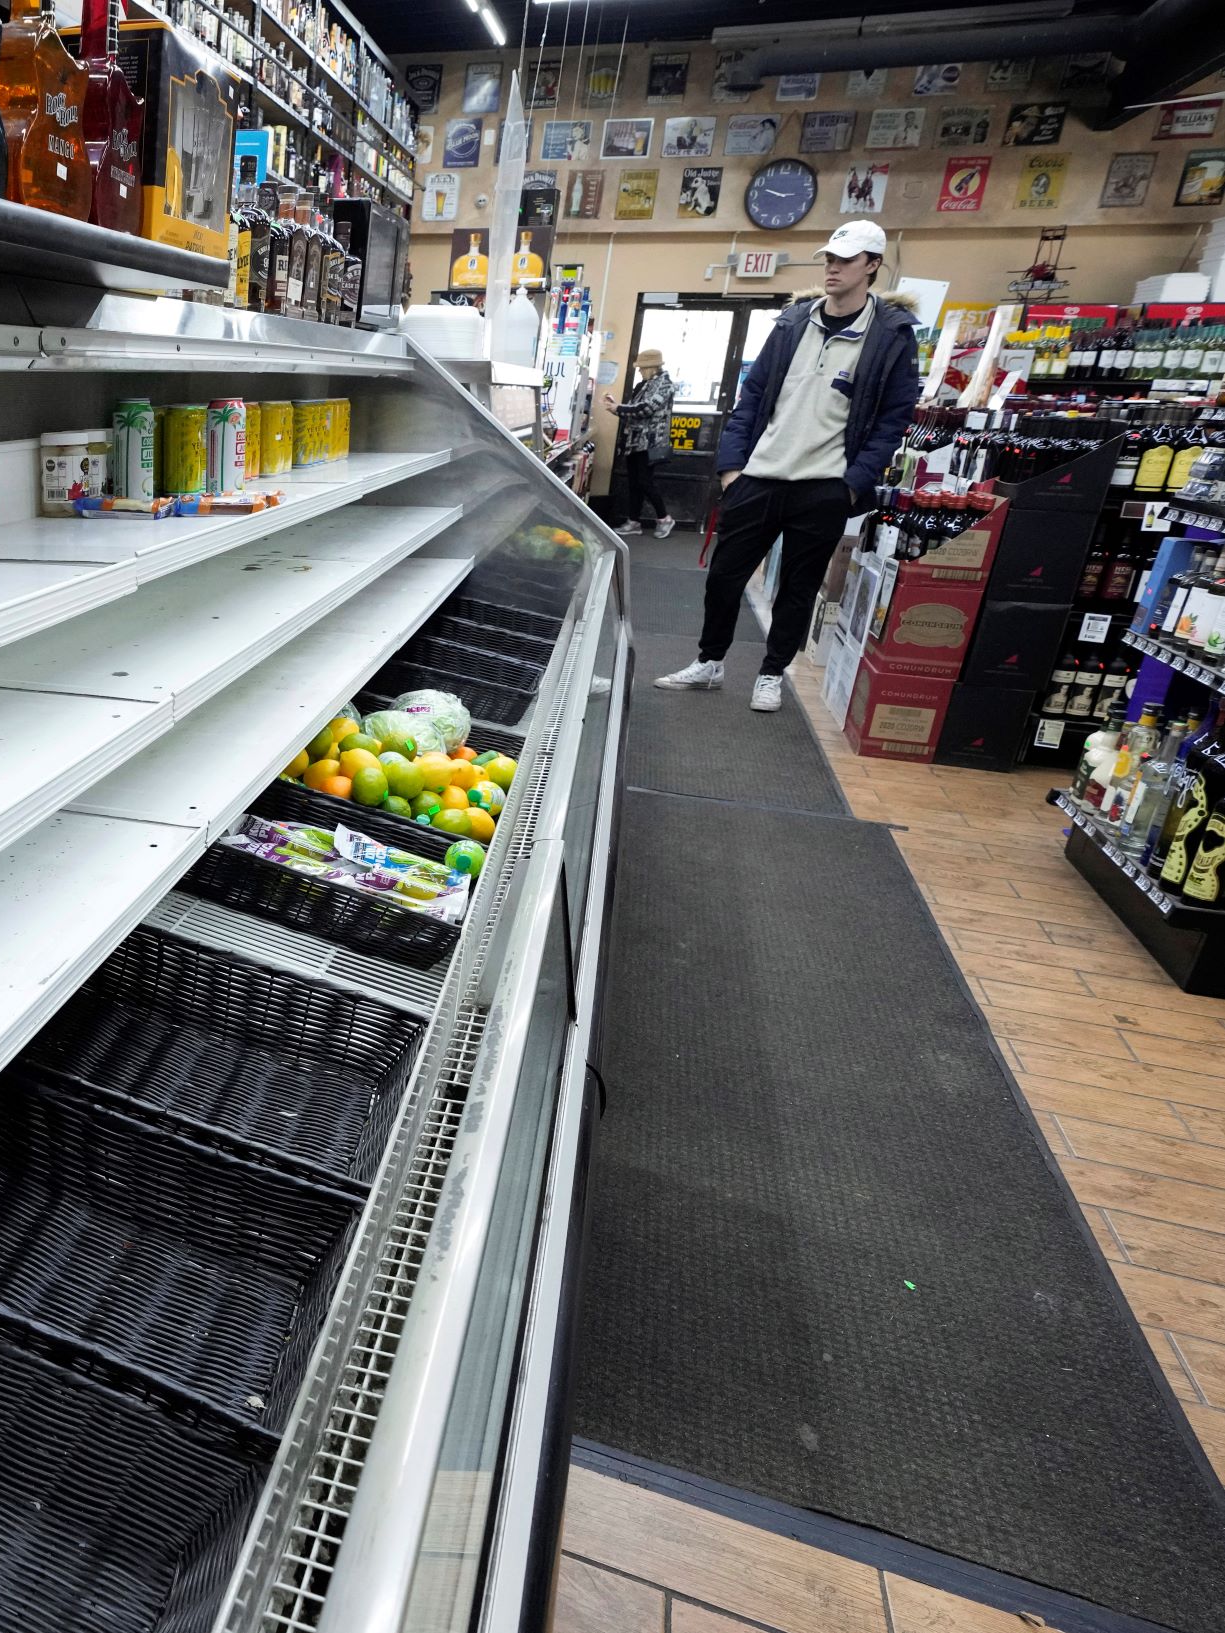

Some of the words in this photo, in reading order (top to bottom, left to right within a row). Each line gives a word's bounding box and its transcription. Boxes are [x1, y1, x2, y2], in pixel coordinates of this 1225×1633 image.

[60, 105, 78, 127] ROLL
[47, 134, 75, 160] MANGO
[684, 168, 697, 178] Old
[767, 167, 775, 177] 11
[779, 163, 792, 175] 12
[798, 165, 803, 176] 1
[754, 176, 765, 187] 10
[803, 174, 813, 186] 2
[749, 189, 758, 200] 9
[751, 202, 759, 213] 8
[797, 201, 806, 213] 4
[941, 198, 977, 210] Coca-Cola
[760, 213, 768, 224] 7
[771, 215, 780, 226] 6
[787, 211, 795, 223] 5
[744, 253, 773, 273] EXIT
[671, 416, 701, 428] WOOD
[670, 428, 687, 438] OR
[673, 438, 695, 450] LE
[902, 619, 963, 630] CONUNDRUM
[889, 663, 952, 674] CONUNDRUM
[881, 690, 939, 700] CONUNDRUM
